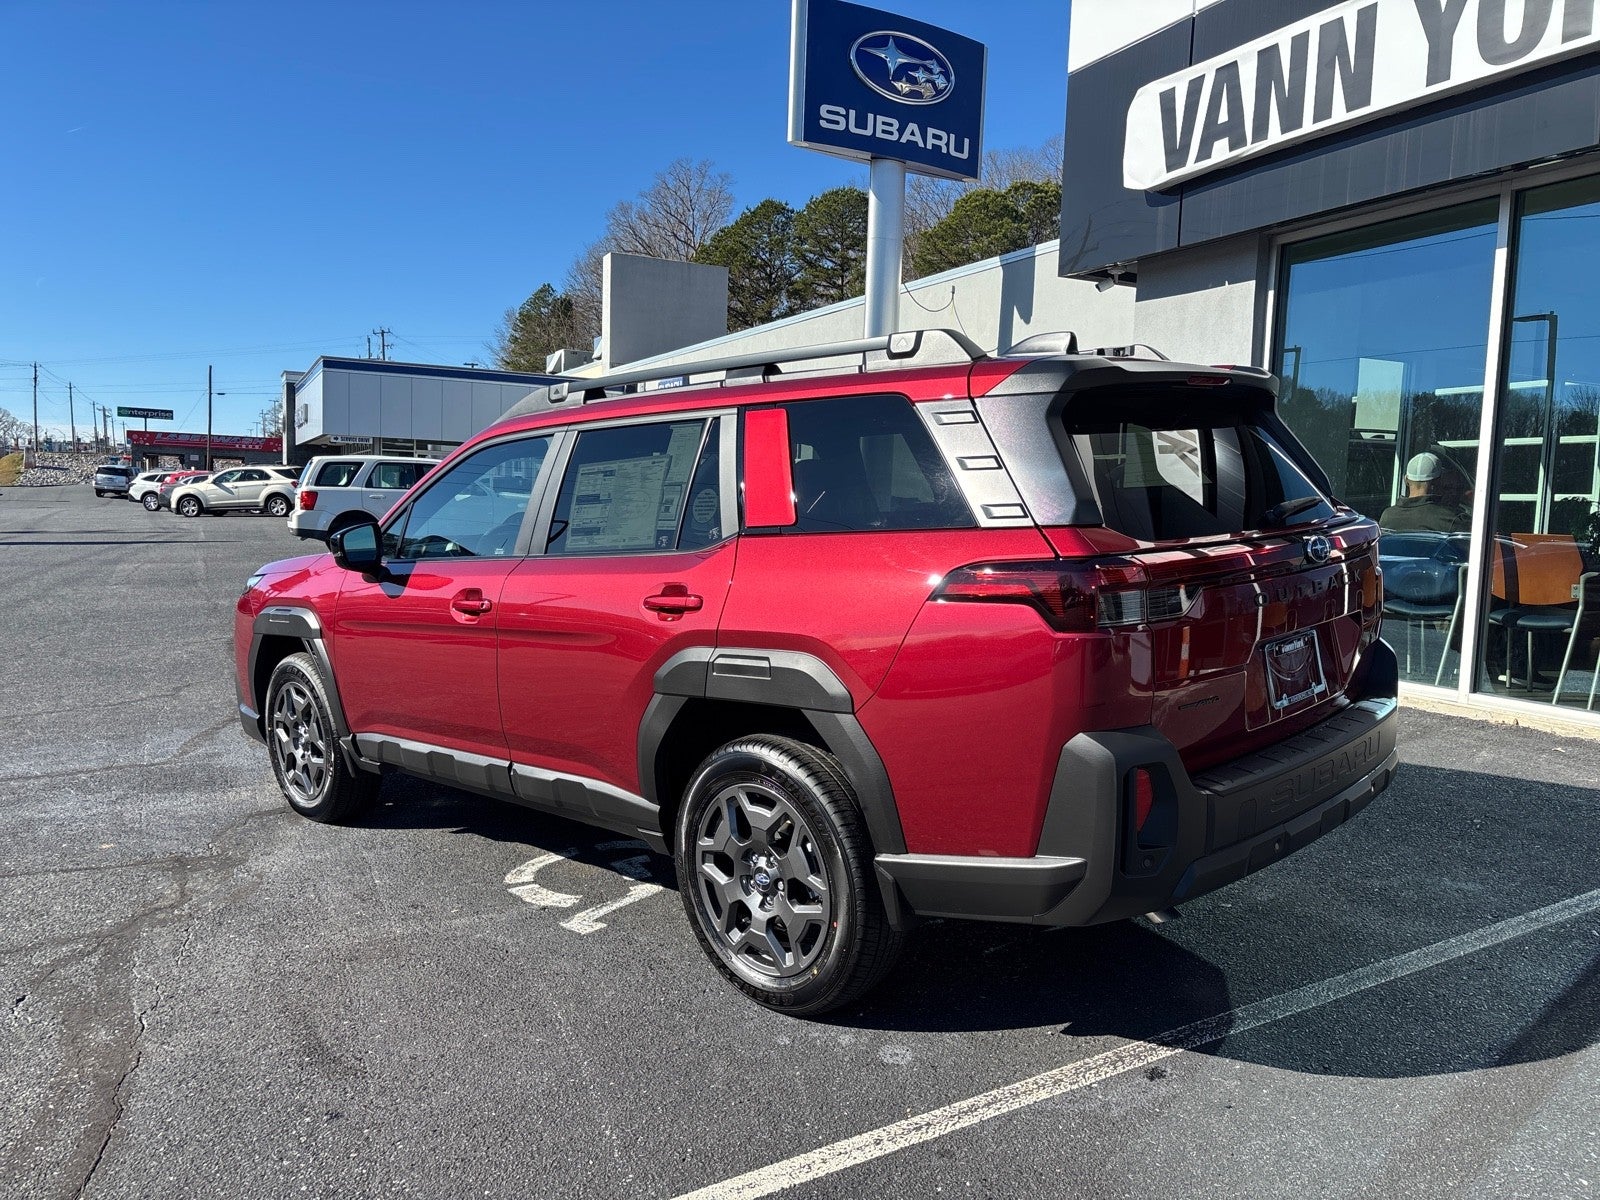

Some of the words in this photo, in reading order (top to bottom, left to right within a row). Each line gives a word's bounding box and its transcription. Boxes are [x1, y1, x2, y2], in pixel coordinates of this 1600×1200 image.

[1159, 2, 1378, 174] VANN
[819, 104, 970, 160] SUBARU
[120, 409, 172, 417] enterprise
[1254, 569, 1361, 608] OUTBACK
[1270, 731, 1381, 814] SUBARU
